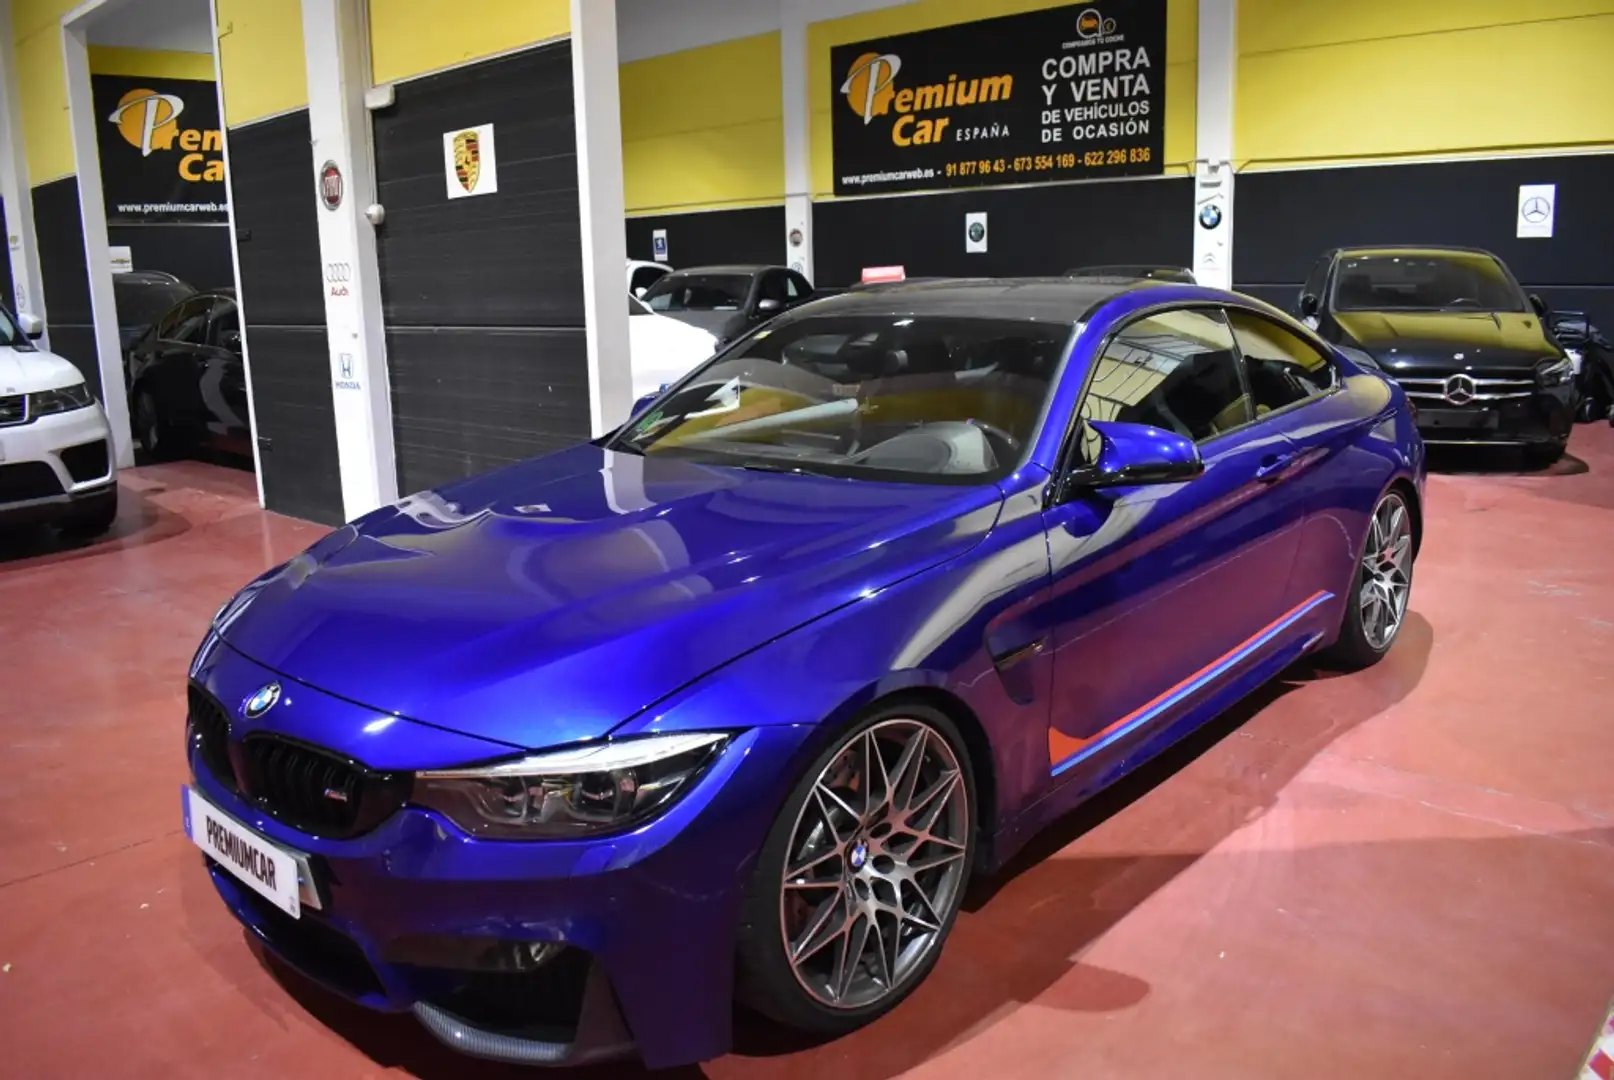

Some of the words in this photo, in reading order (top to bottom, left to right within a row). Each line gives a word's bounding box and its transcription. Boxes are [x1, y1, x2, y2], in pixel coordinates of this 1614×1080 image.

[1042, 46, 1151, 80] COMPRA
[840, 53, 1013, 126] Premium
[1041, 83, 1057, 106] Y
[1070, 73, 1151, 103] VENTA
[1042, 109, 1061, 125] DE
[1064, 100, 1150, 122] VEHÍCULOS
[892, 114, 949, 147] Car
[956, 122, 1010, 142] ESPAÑA
[1042, 128, 1063, 143] DE
[1073, 118, 1149, 140] OCASIÓN
[178, 153, 224, 182] Ca
[842, 167, 935, 186] www.premiumcarweb.es
[945, 163, 957, 177] 91
[960, 161, 977, 176] 877
[979, 160, 991, 174] 96
[993, 159, 1006, 173] 43
[1014, 157, 1032, 172] 673
[1034, 155, 1053, 170] 554
[1056, 153, 1075, 168] 169
[1084, 151, 1105, 166] 622
[1106, 148, 1127, 165] 296
[1130, 147, 1151, 163] 836
[206, 815, 277, 892] PREMIUMCAR
